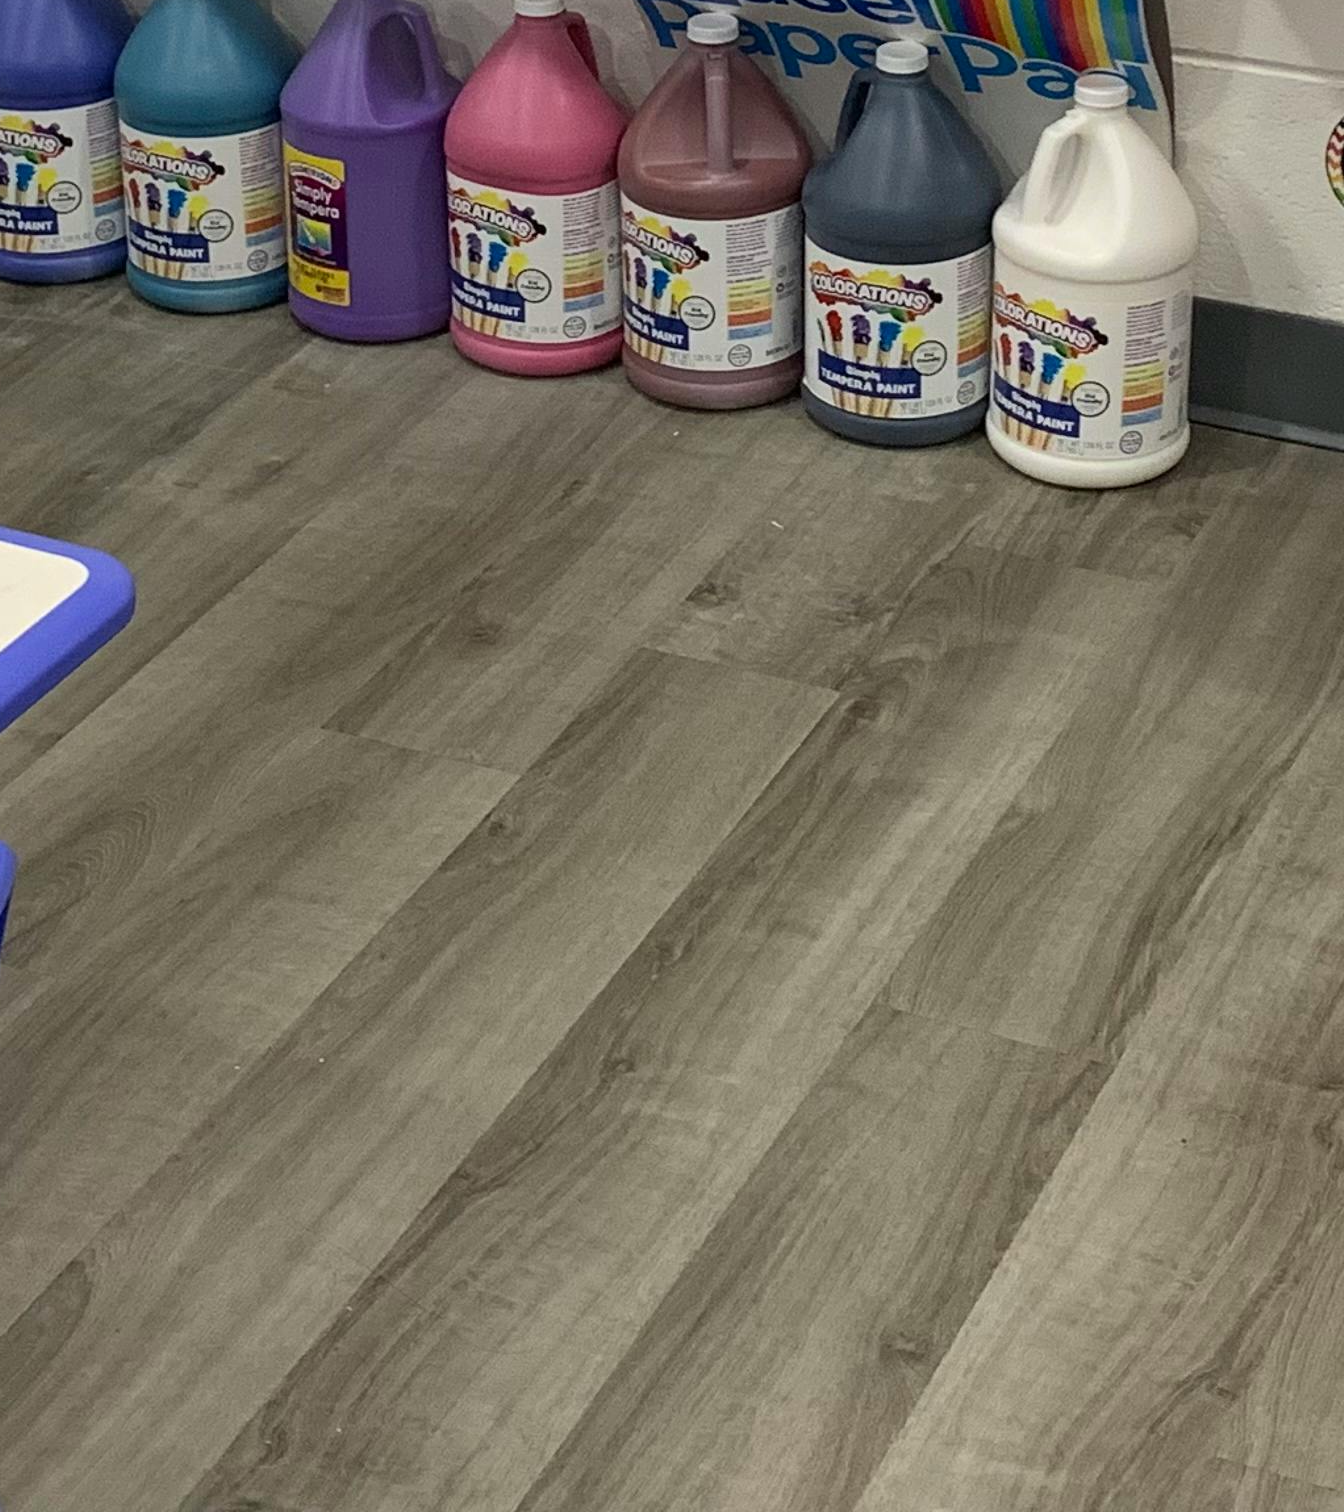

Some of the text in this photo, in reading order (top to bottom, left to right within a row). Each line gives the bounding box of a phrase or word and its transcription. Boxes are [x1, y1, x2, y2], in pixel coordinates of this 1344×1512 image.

[814, 275, 926, 310] COLORATIONS
[820, 367, 916, 394] TEMPERA PAINT
[1037, 414, 1075, 432] PAINT
